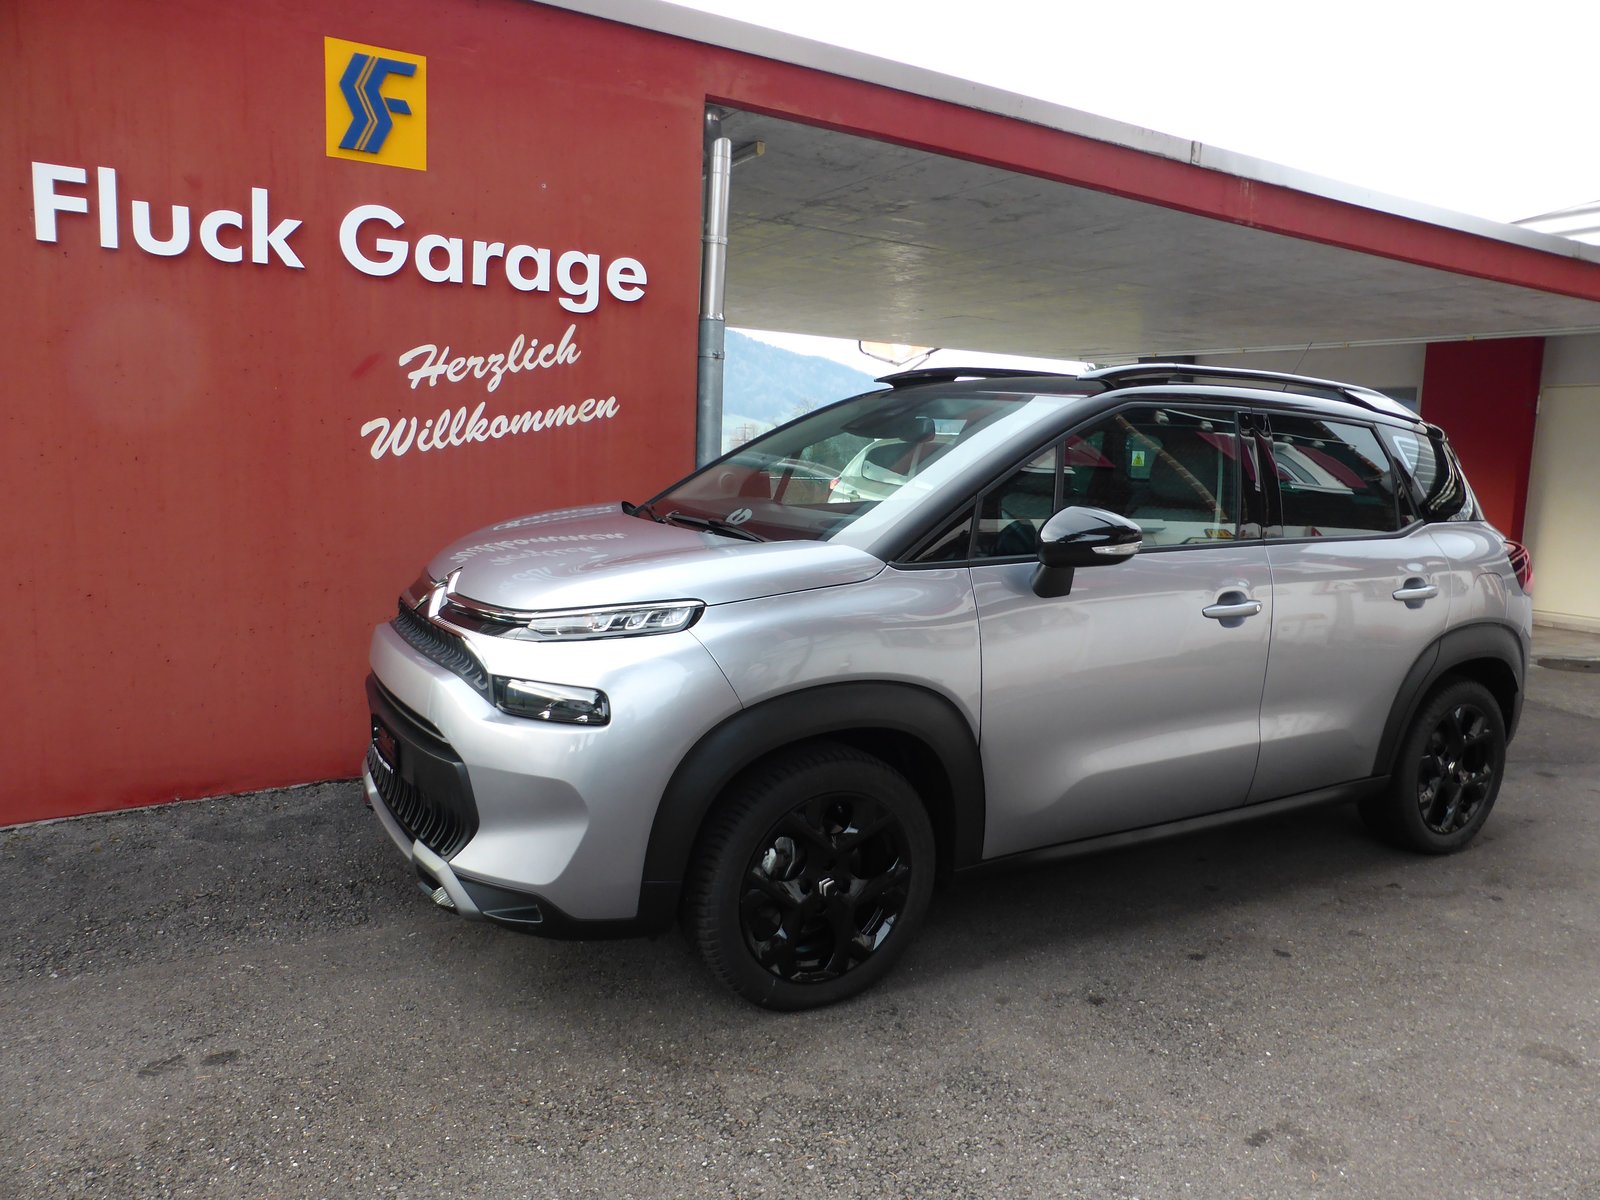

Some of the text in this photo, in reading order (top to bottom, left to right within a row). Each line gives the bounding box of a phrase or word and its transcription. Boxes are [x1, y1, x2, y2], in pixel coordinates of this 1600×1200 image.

[31, 161, 648, 314] Fluck Garage
[398, 323, 582, 393] Herzlich
[360, 395, 621, 460] Willkommen
